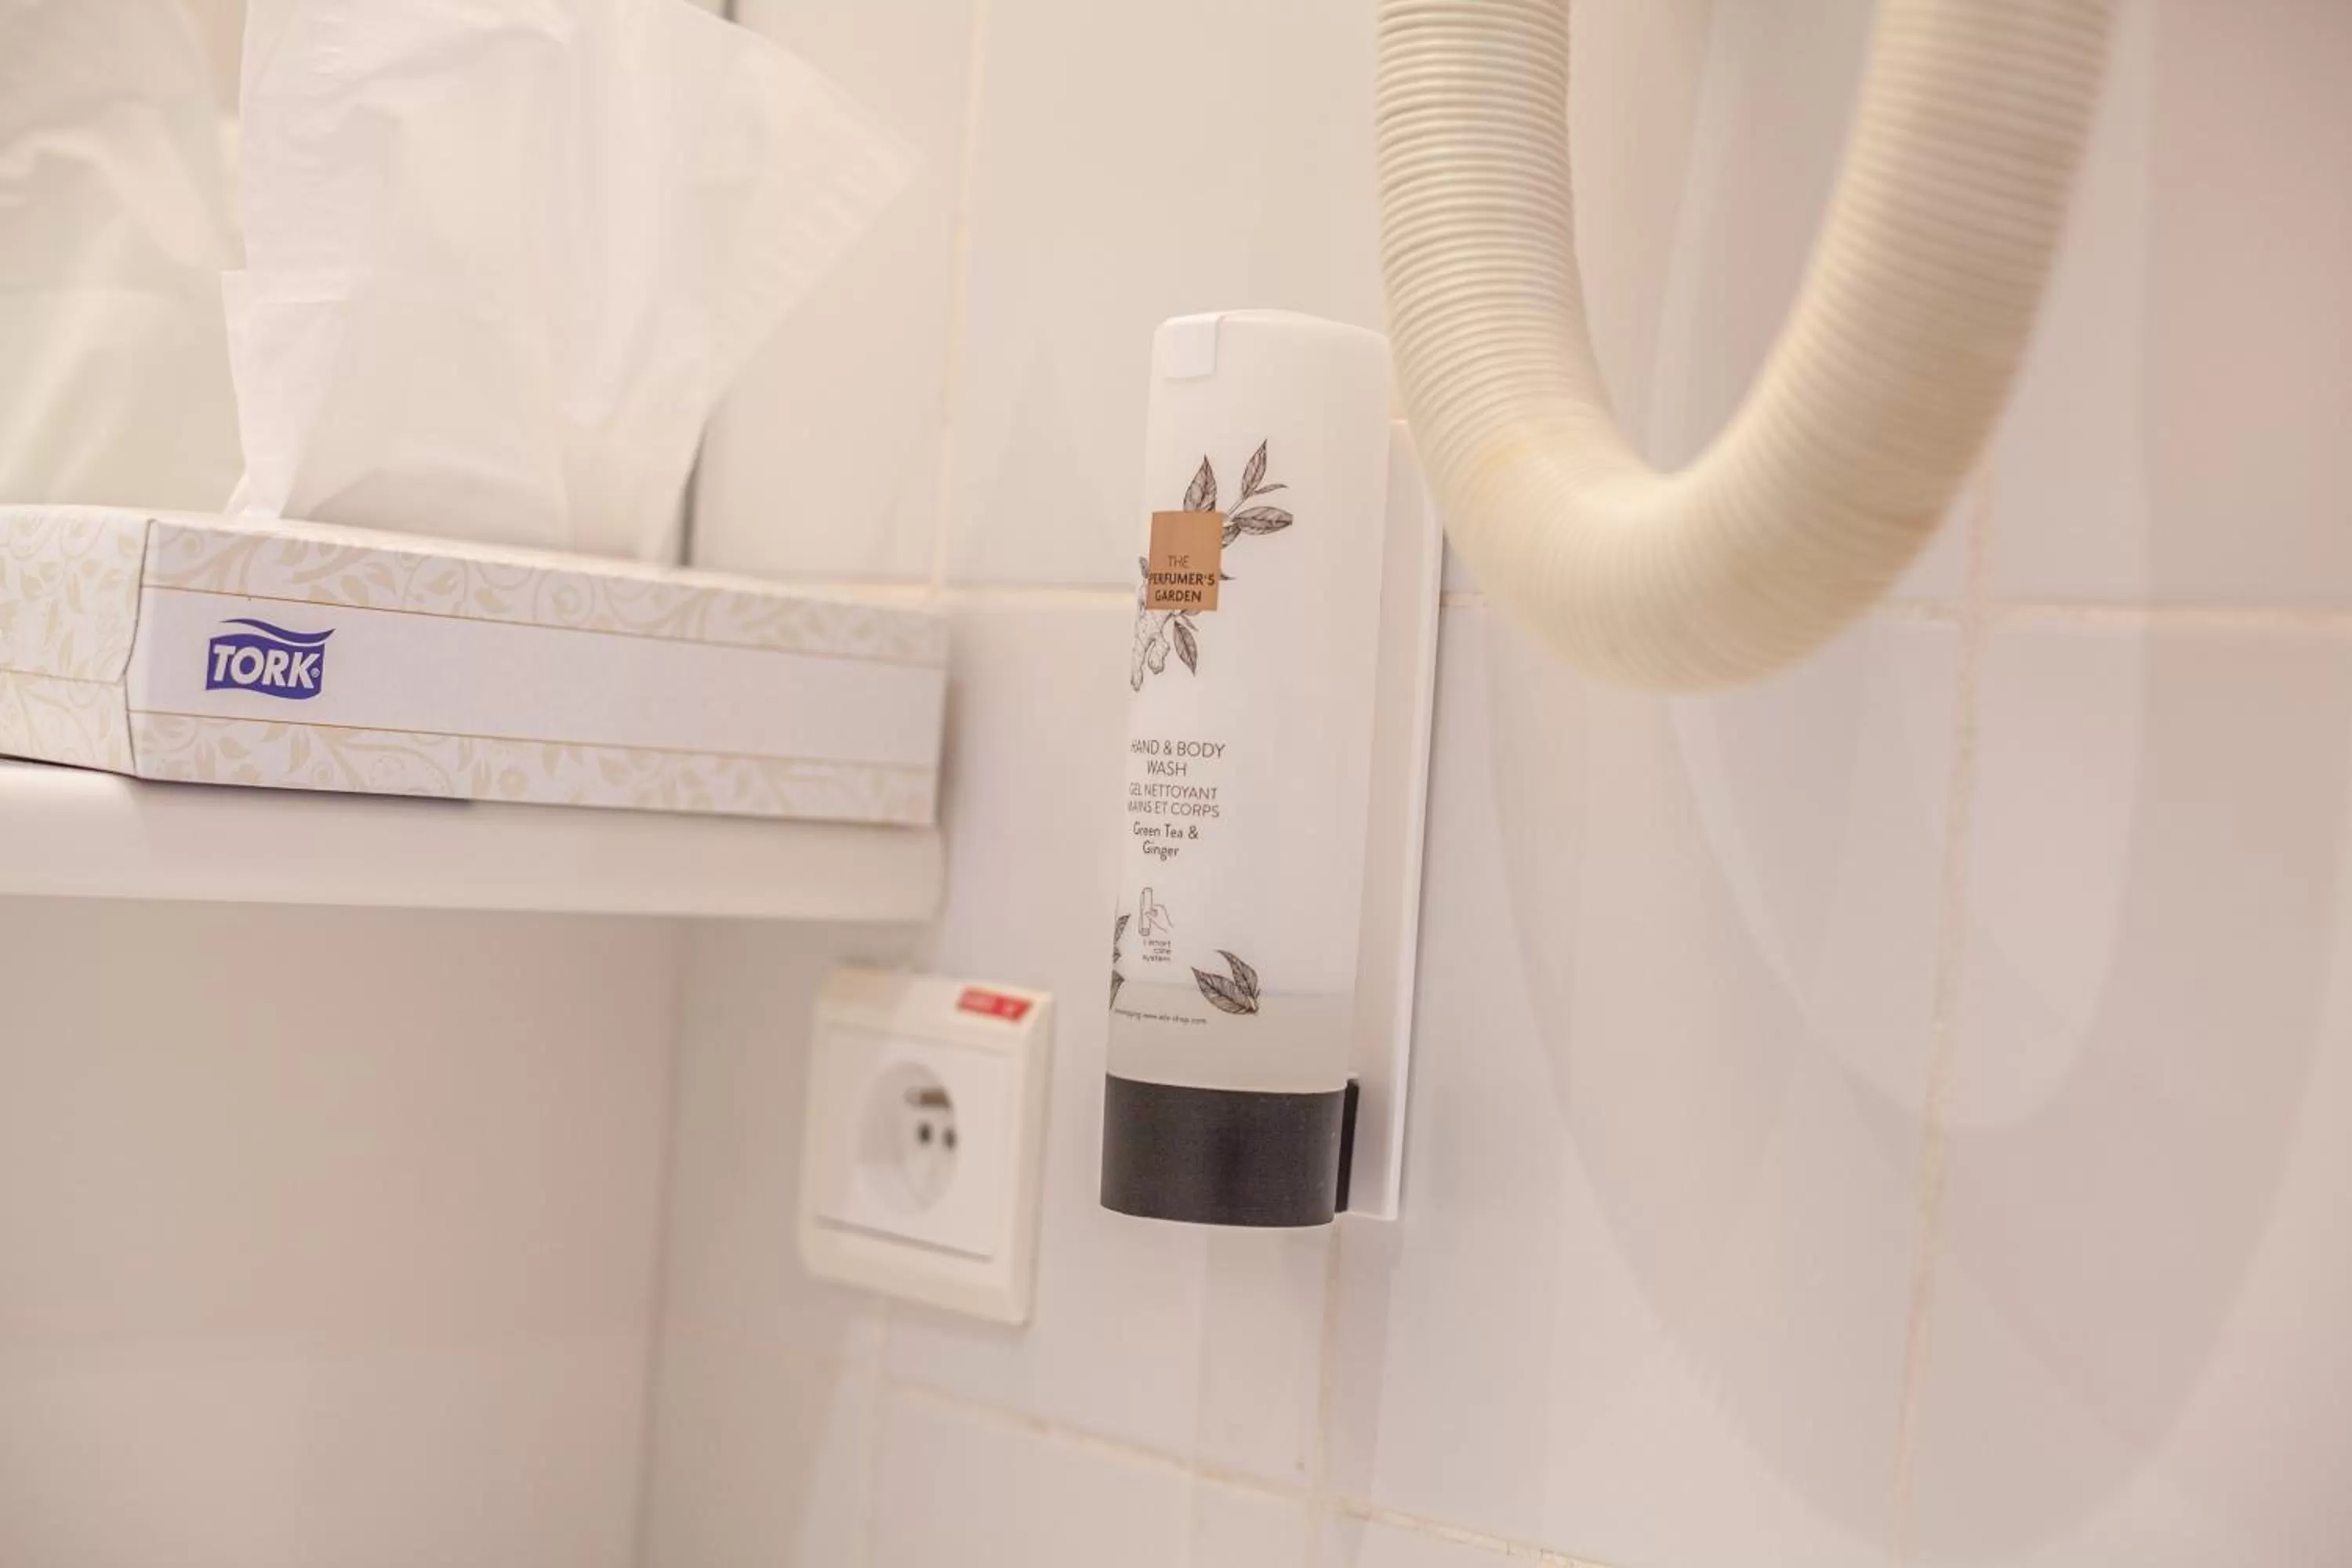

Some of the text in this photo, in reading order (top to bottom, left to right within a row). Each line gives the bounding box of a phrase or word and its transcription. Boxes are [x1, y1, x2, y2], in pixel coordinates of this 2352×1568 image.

[1167, 554, 1190, 568] THE
[1154, 589, 1202, 602] GARDEN
[1163, 740, 1172, 756] &
[1176, 741, 1226, 759] BODY
[1147, 760, 1187, 777] WASH
[1144, 783, 1218, 800] NETTOYANT
[1154, 801, 1167, 815] ET
[1171, 802, 1220, 818] CORPS
[1133, 821, 1199, 840] Green Tea &
[1142, 840, 1180, 862] Ginger
